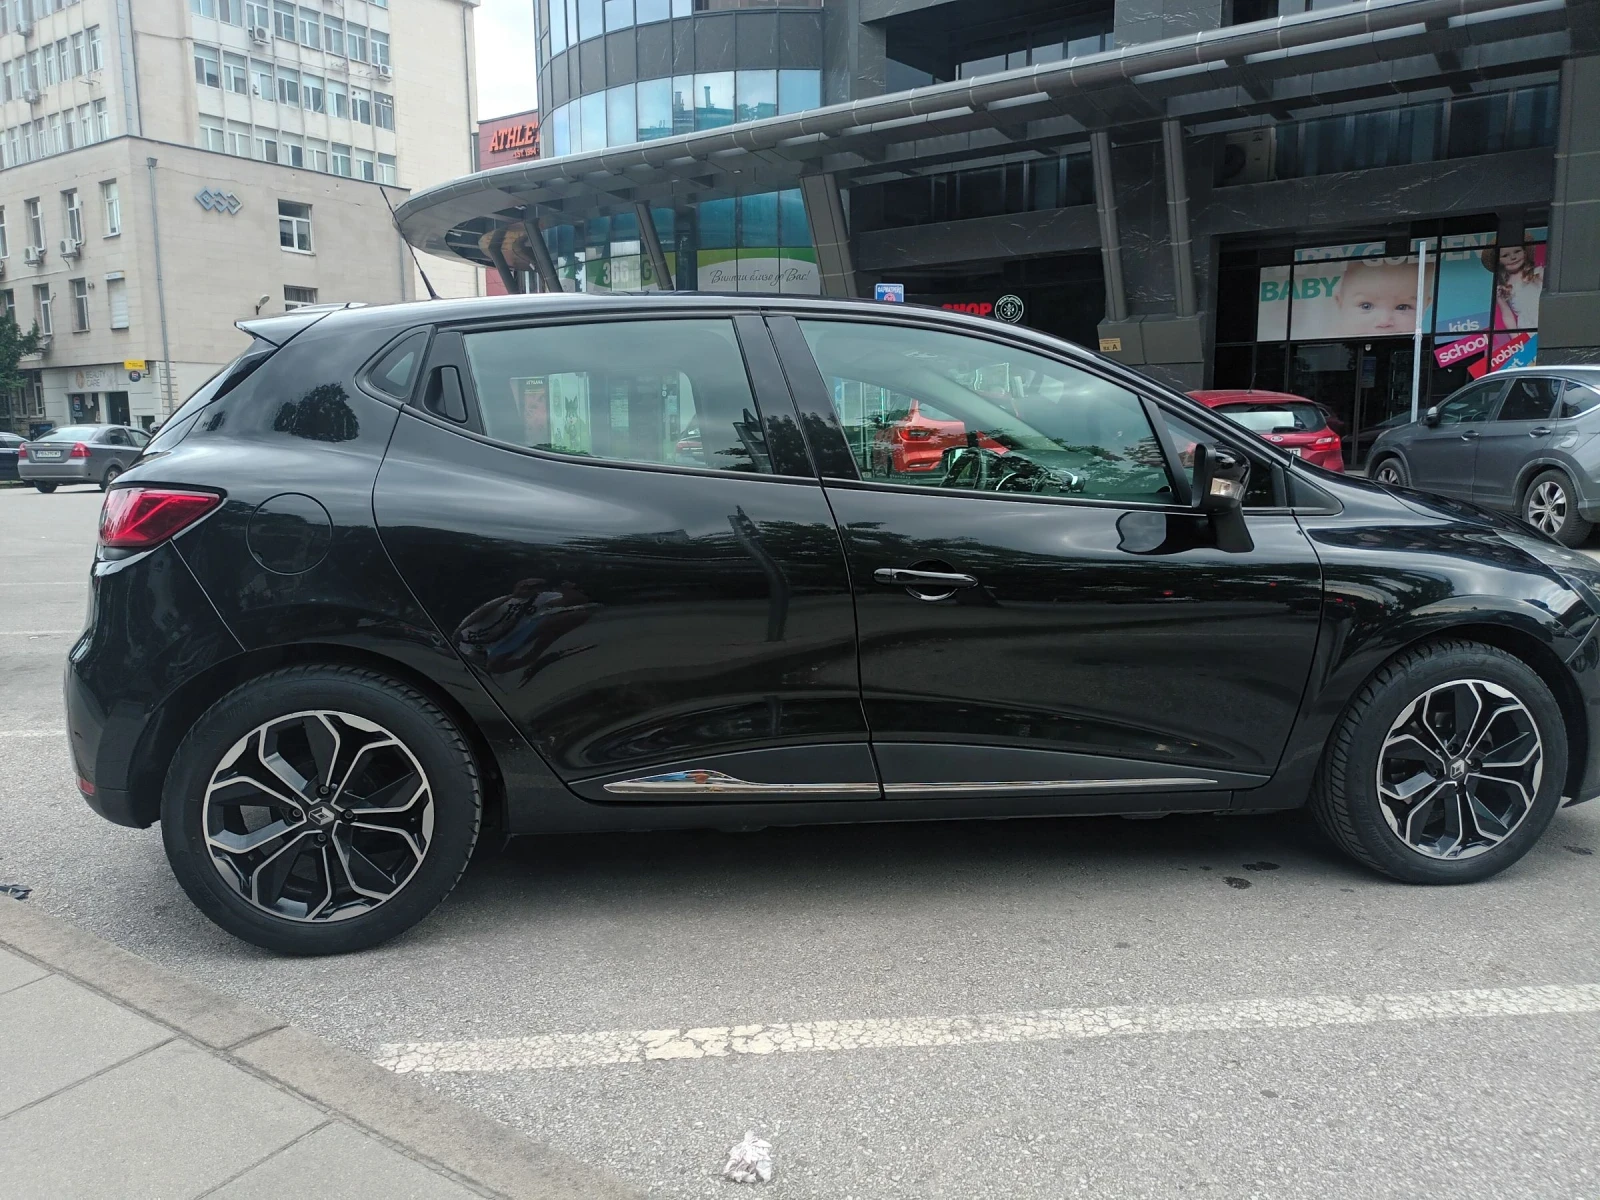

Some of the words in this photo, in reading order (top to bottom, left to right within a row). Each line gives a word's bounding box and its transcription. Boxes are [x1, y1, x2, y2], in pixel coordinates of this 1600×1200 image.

[1261, 276, 1341, 302] BABY
[1448, 319, 1480, 333] kids
[1439, 333, 1489, 363] school
